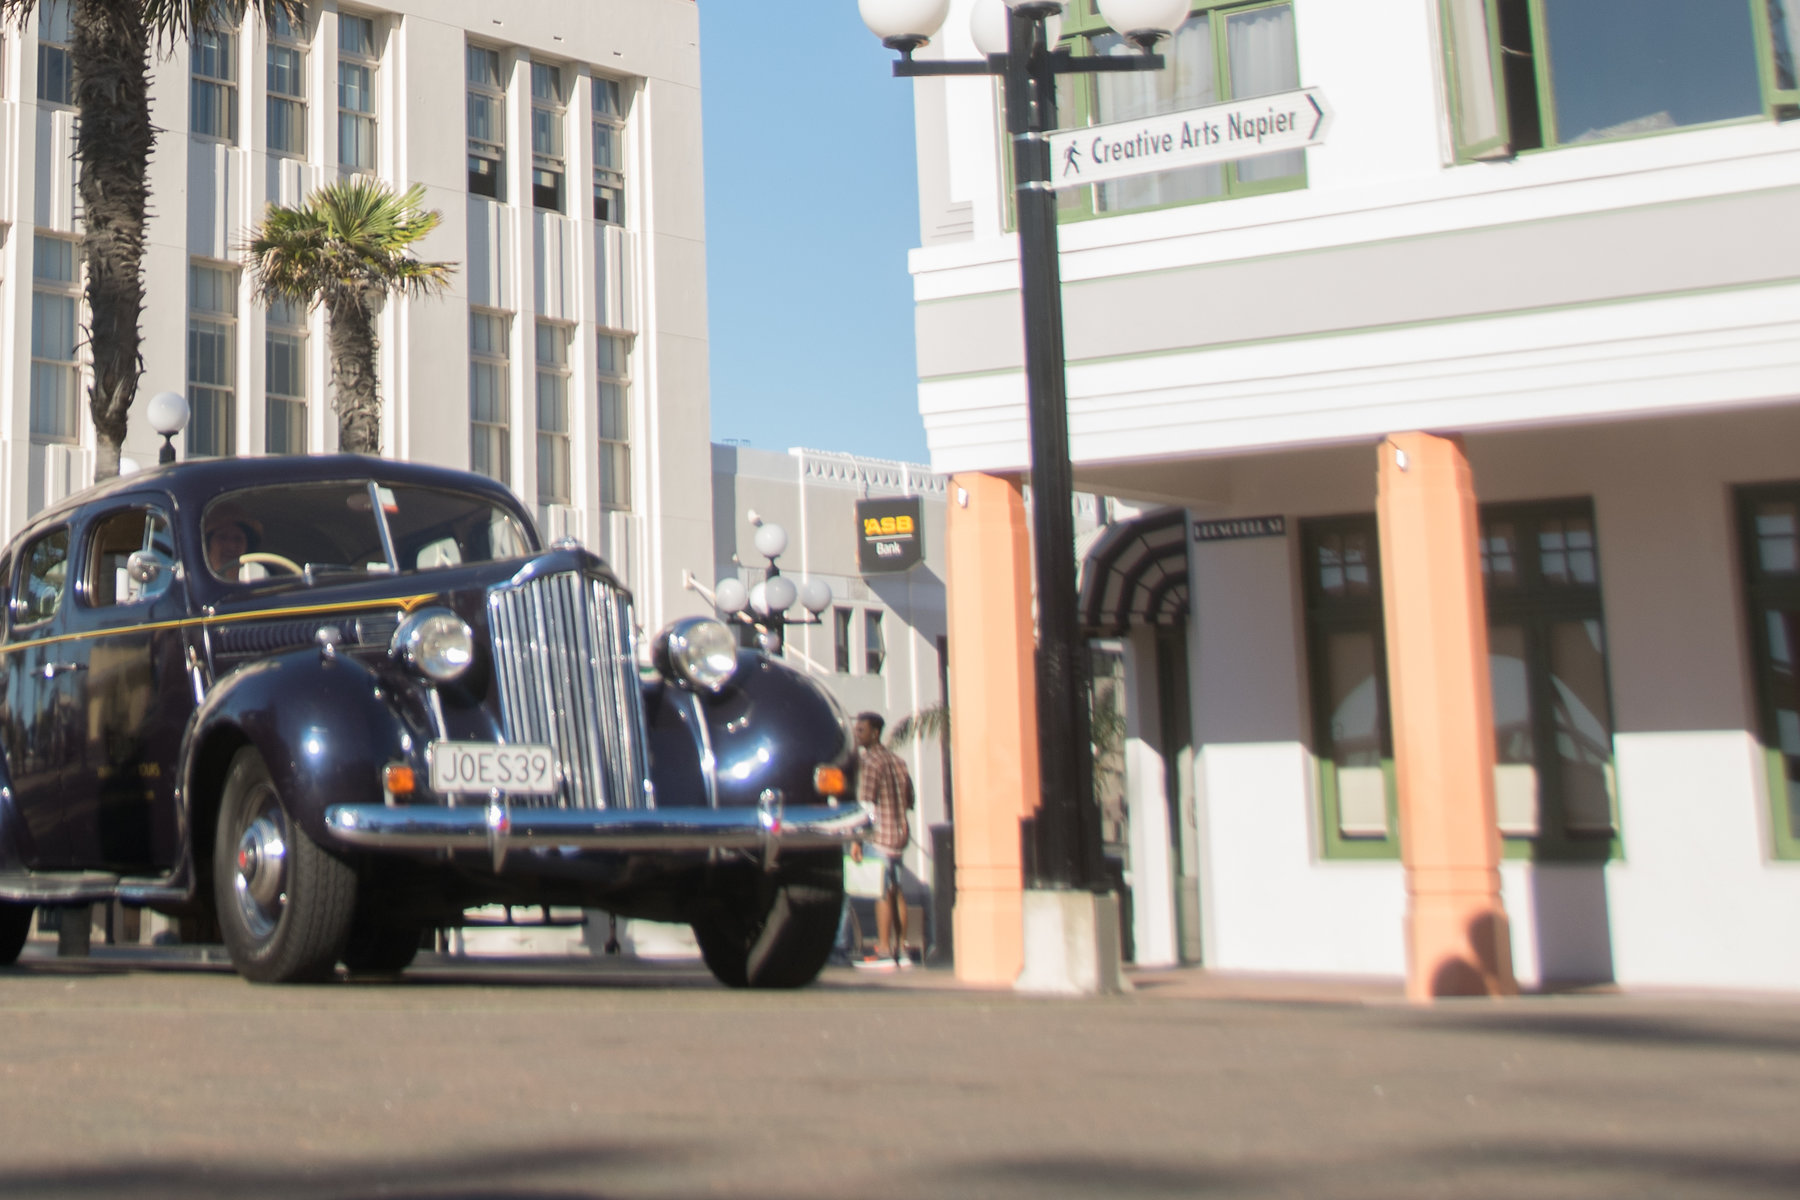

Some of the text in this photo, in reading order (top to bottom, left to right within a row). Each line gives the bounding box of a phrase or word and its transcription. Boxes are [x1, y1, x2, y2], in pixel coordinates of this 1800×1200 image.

[1091, 107, 1296, 164] Creative Arts Napier
[864, 515, 914, 535] ASB
[876, 542, 902, 557] Bank
[443, 752, 547, 783] JOES39
